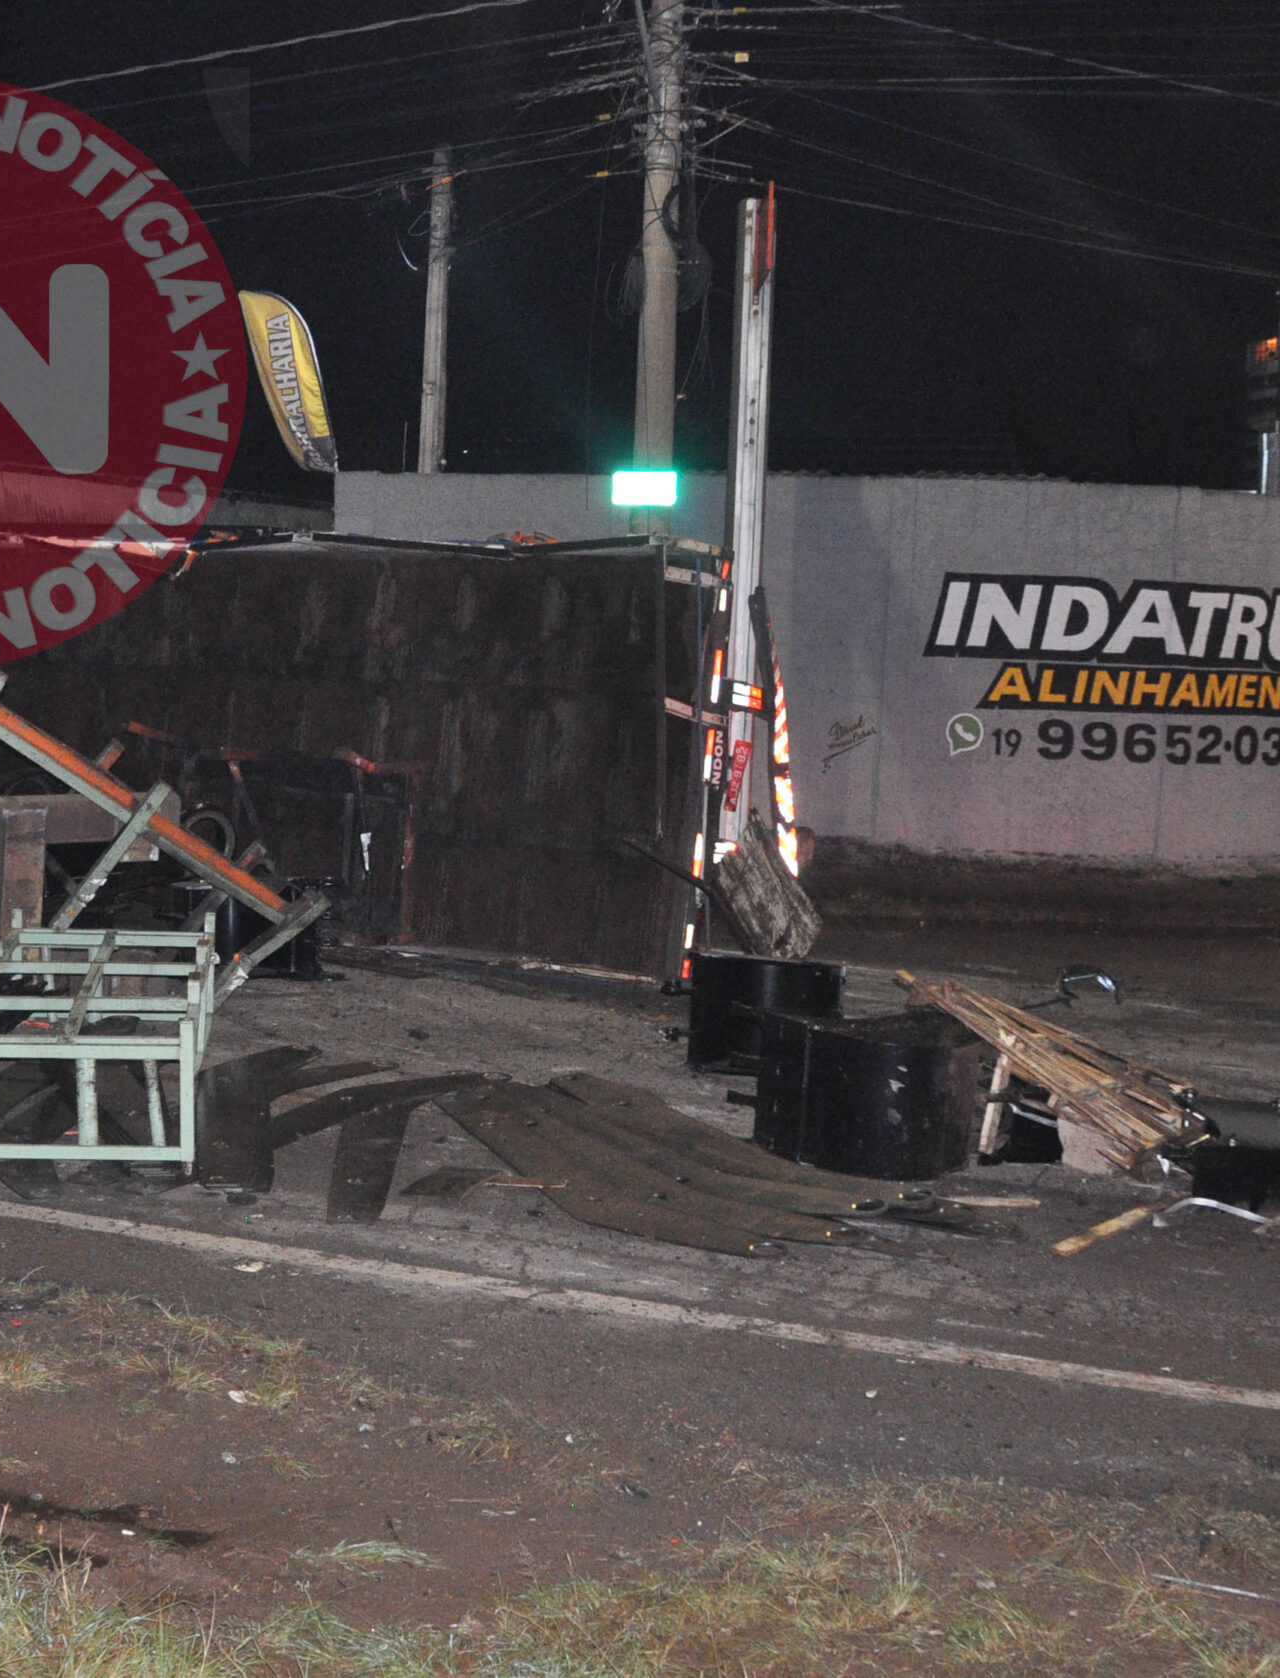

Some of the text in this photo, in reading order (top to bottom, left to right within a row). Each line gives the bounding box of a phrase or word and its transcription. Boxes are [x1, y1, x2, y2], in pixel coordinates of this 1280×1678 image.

[933, 579, 1280, 663] INDATR
[711, 730, 724, 789] NDON
[991, 728, 1022, 757] 19
